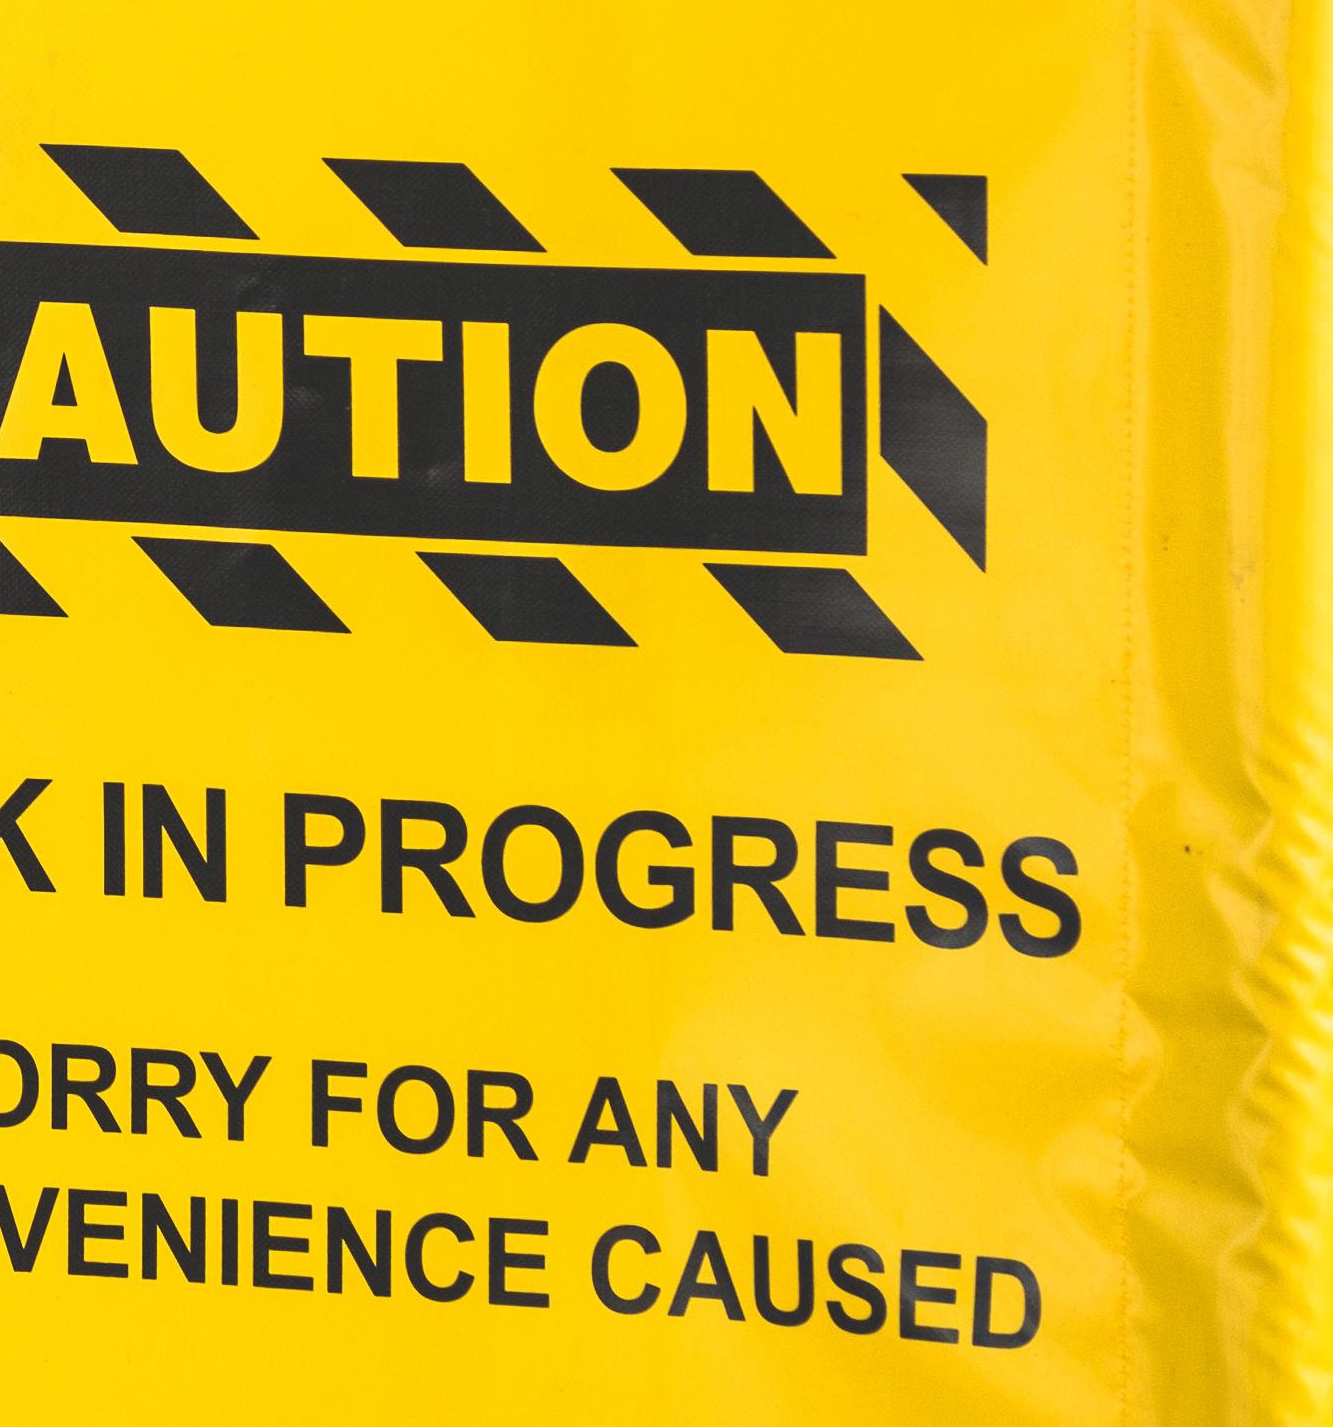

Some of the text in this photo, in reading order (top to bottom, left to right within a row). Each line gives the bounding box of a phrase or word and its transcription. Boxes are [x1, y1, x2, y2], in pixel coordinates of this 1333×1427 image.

[104, 782, 226, 902] IN
[285, 793, 1081, 957] PROGRESS
[312, 1060, 538, 1160] FOR
[569, 1077, 797, 1176] ANY
[592, 1225, 1040, 1348] CAUSED
